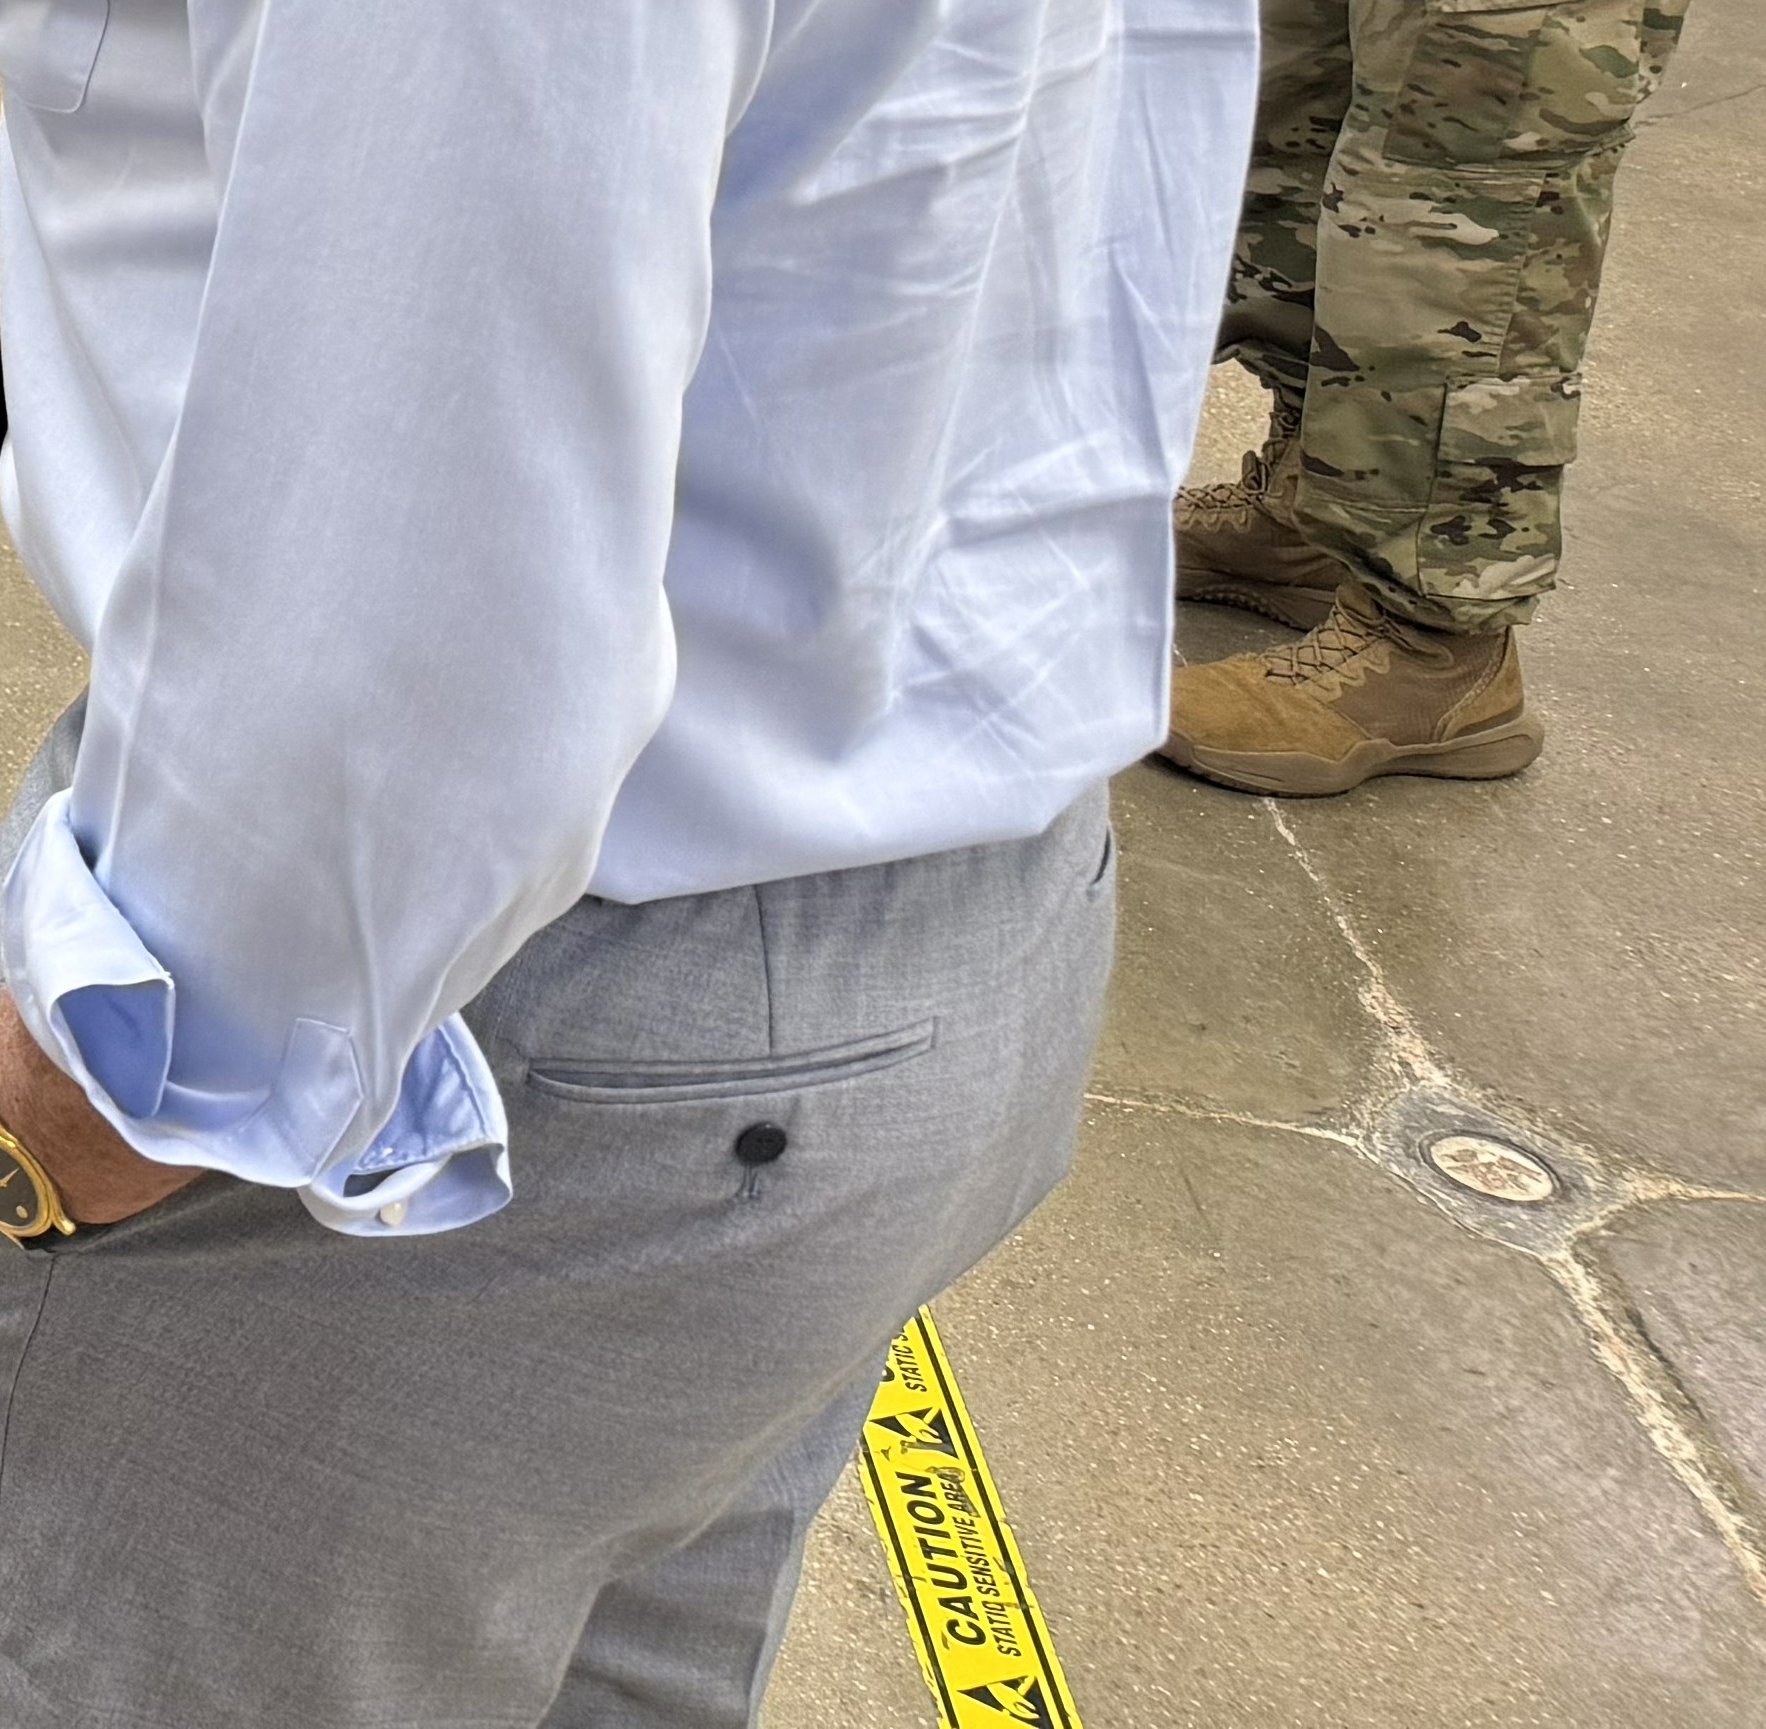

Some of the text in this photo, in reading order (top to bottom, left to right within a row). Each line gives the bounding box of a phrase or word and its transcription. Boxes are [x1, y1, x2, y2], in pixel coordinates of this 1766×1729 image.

[891, 1344, 927, 1393] STATIC
[894, 1471, 987, 1646] CAUTION
[937, 1471, 1022, 1658] STATIC SENSITIVE AREA
